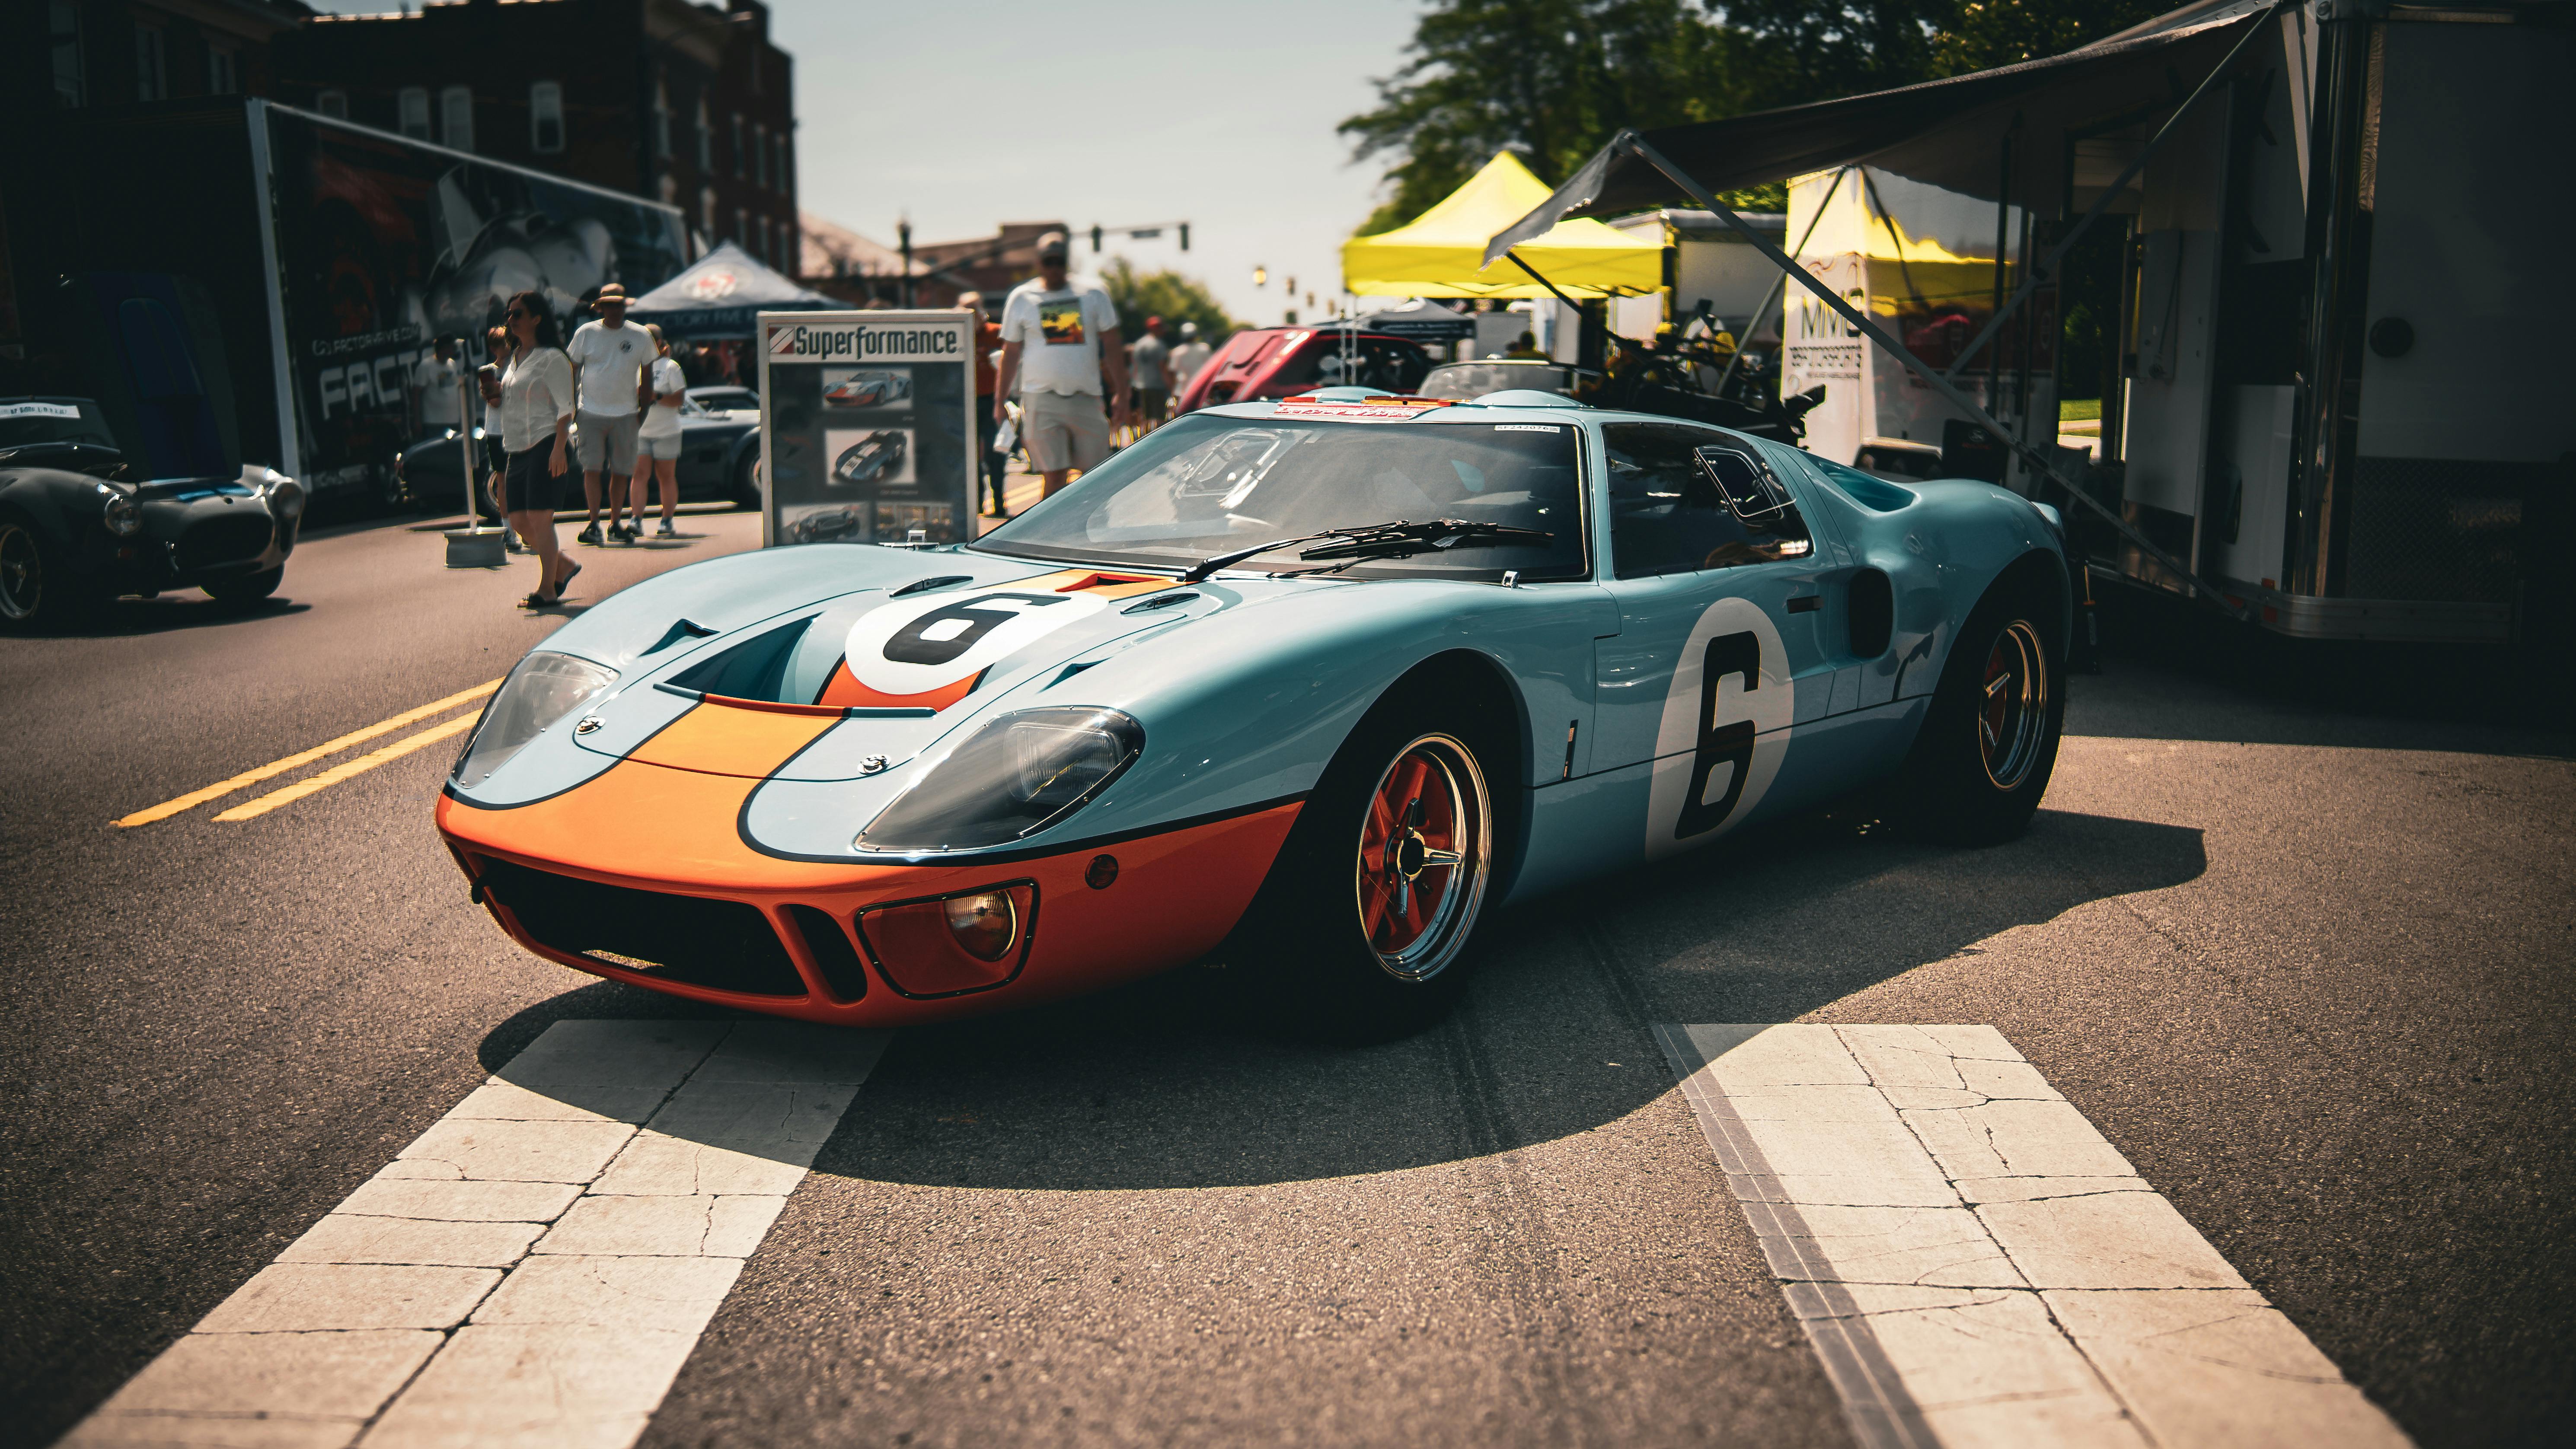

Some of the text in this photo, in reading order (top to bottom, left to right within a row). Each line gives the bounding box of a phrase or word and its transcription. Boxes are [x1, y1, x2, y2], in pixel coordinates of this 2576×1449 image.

[795, 326, 957, 360] Superformance
[882, 592, 1072, 666] 6
[1674, 630, 1762, 840] 6
